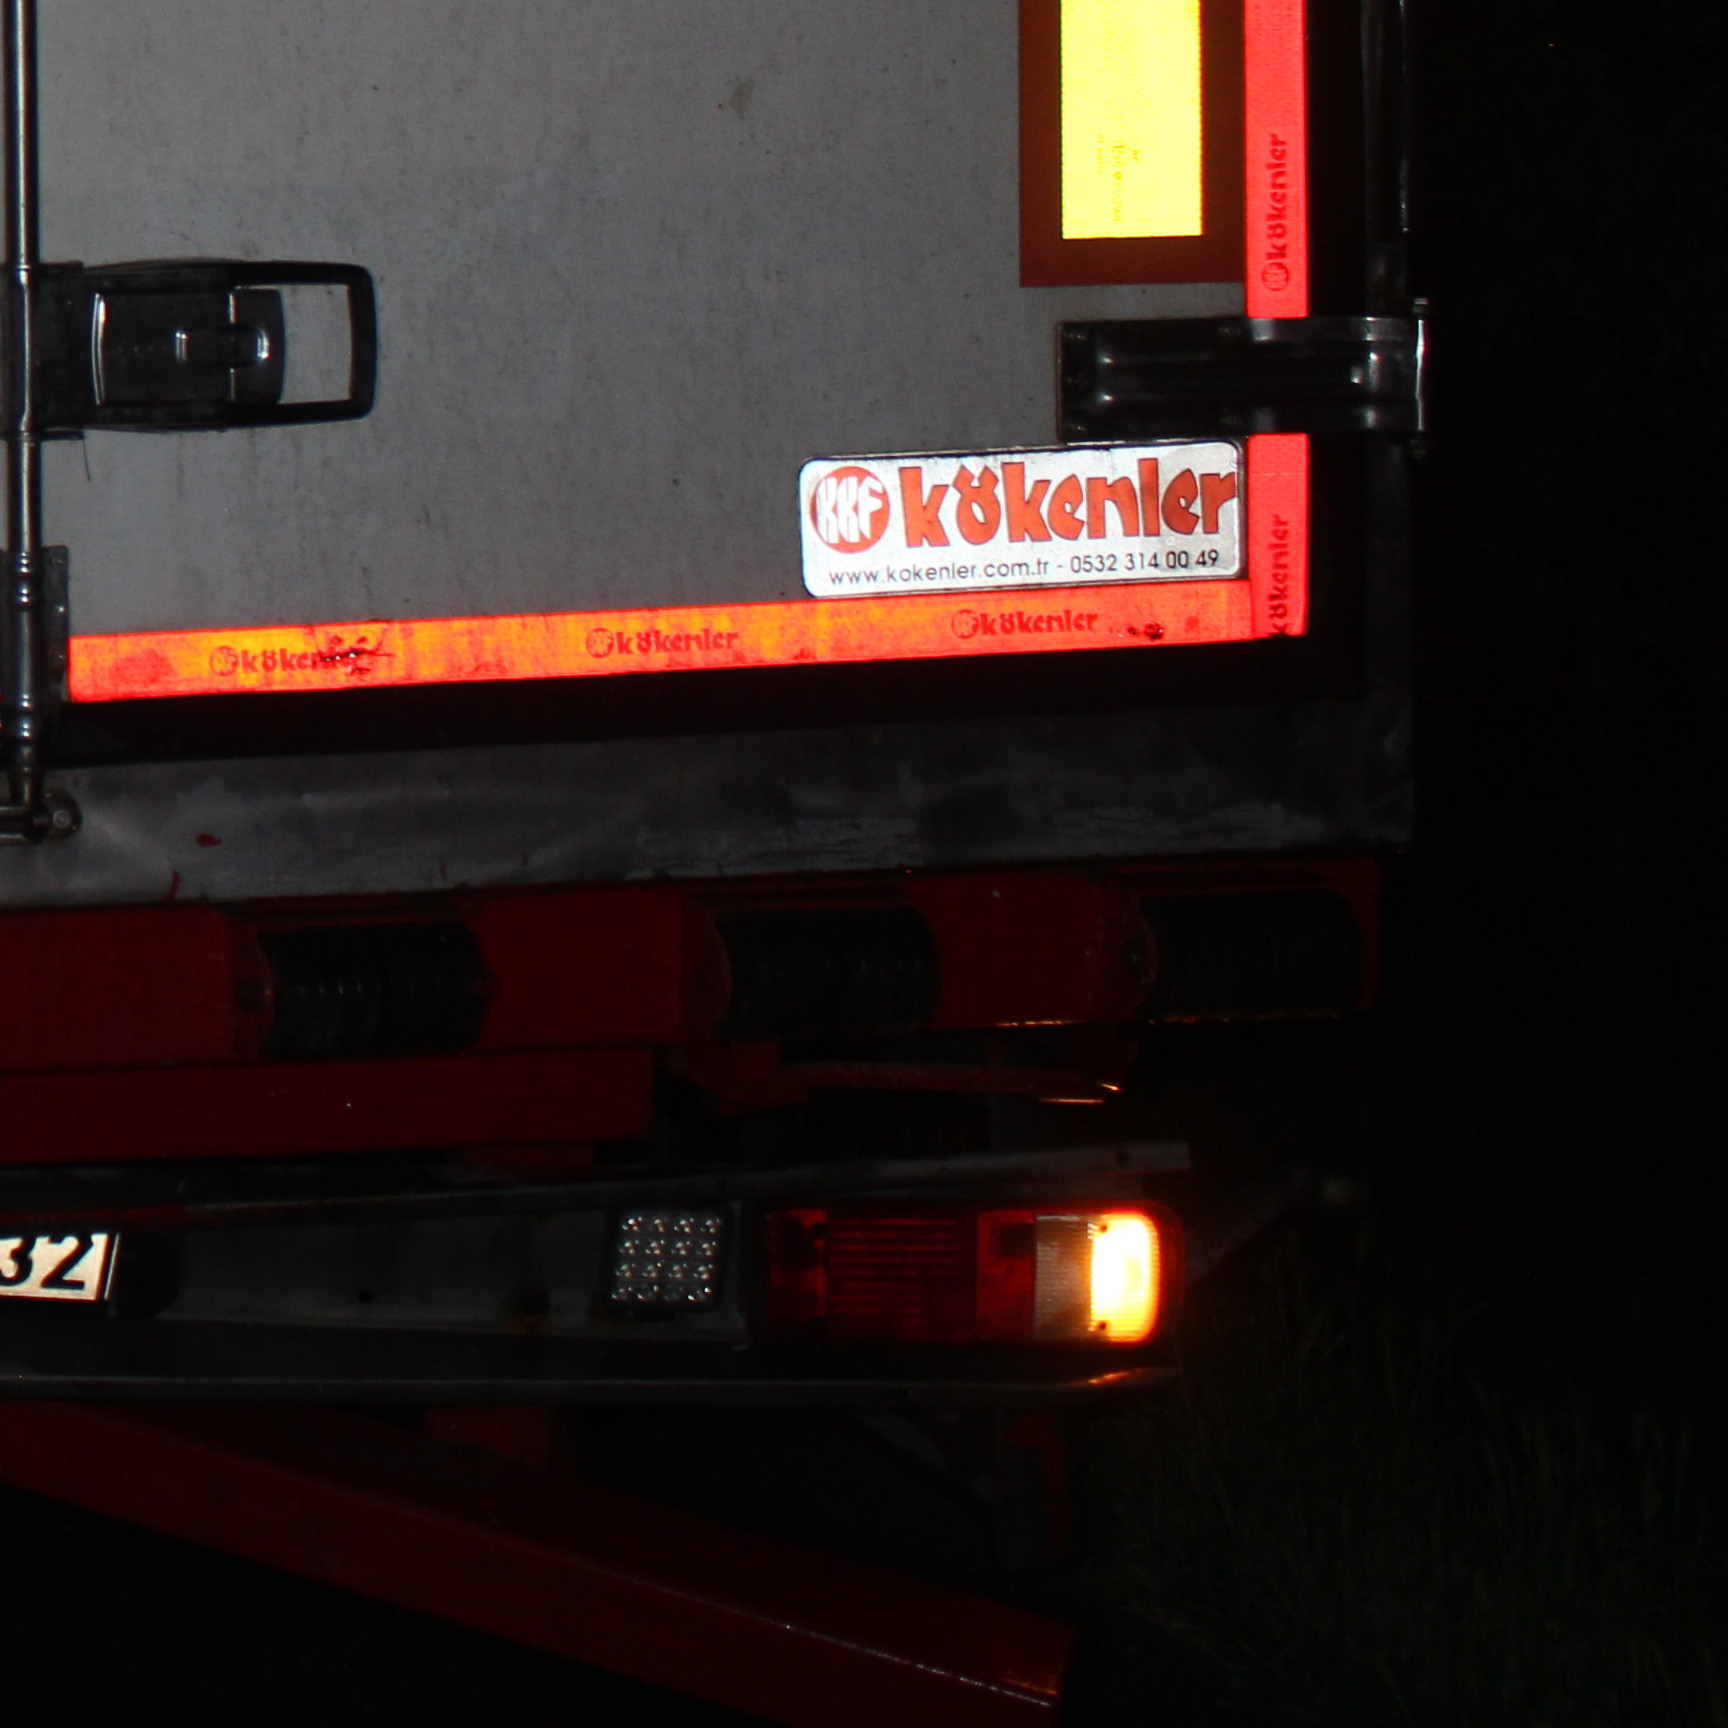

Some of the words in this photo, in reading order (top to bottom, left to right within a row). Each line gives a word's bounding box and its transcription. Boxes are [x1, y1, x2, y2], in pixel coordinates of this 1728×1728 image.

[1265, 134, 1288, 260] kökenler
[899, 458, 1239, 548] kökenler
[829, 559, 1050, 585] www.kokenler.com.tr
[1070, 555, 1118, 573] 0532
[1123, 553, 1159, 571] 314
[1162, 551, 1190, 569] 00
[1194, 549, 1220, 568] 49
[979, 610, 1098, 637] kökenler
[617, 629, 739, 655] kökenler
